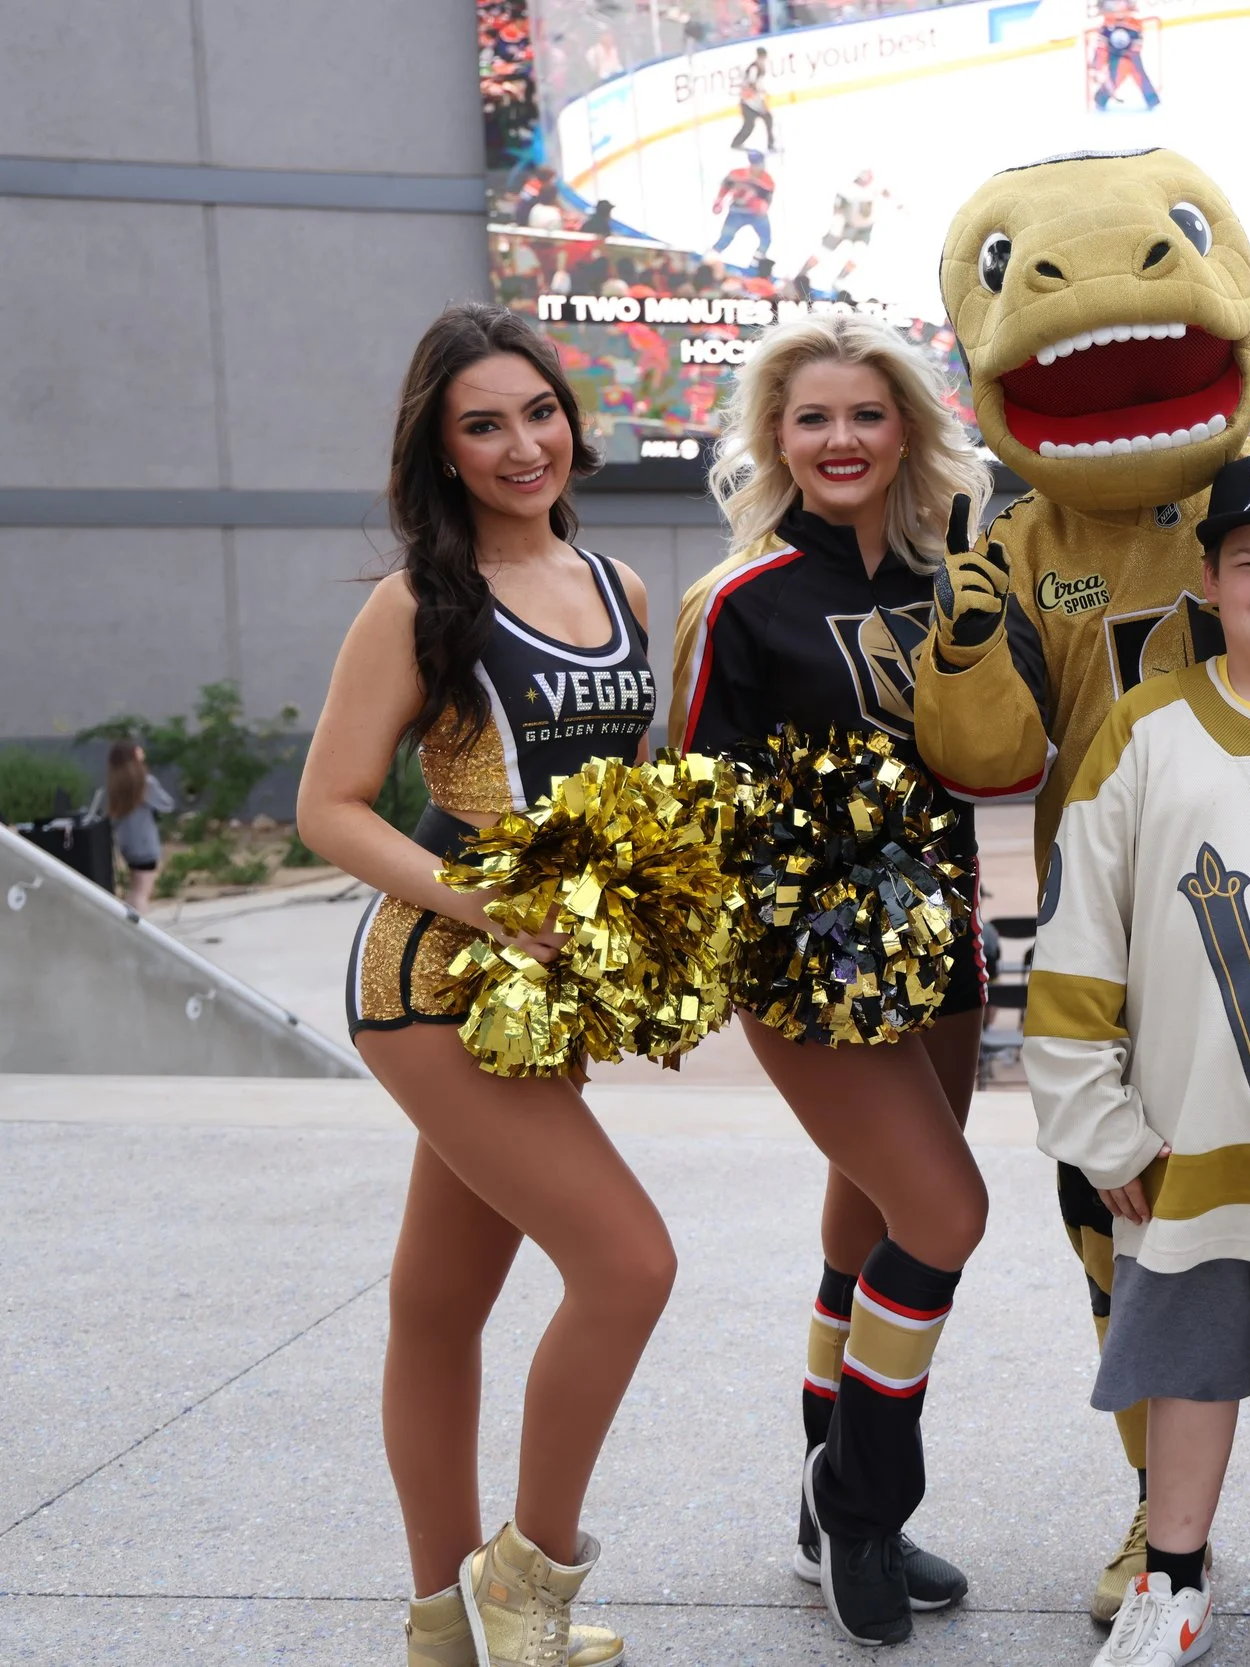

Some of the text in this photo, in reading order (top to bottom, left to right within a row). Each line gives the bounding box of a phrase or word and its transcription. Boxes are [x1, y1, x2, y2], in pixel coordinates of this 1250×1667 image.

[674, 64, 745, 103] Bring
[805, 42, 868, 79] your
[877, 29, 938, 58] best
[570, 296, 643, 322] TWO
[644, 297, 774, 326] MINUTES
[1160, 506, 1176, 524] NHL
[1037, 571, 1105, 610] Circa
[1064, 589, 1110, 614] SPORTS
[532, 670, 656, 724] VEGAS
[525, 723, 595, 743] GOLDEN
